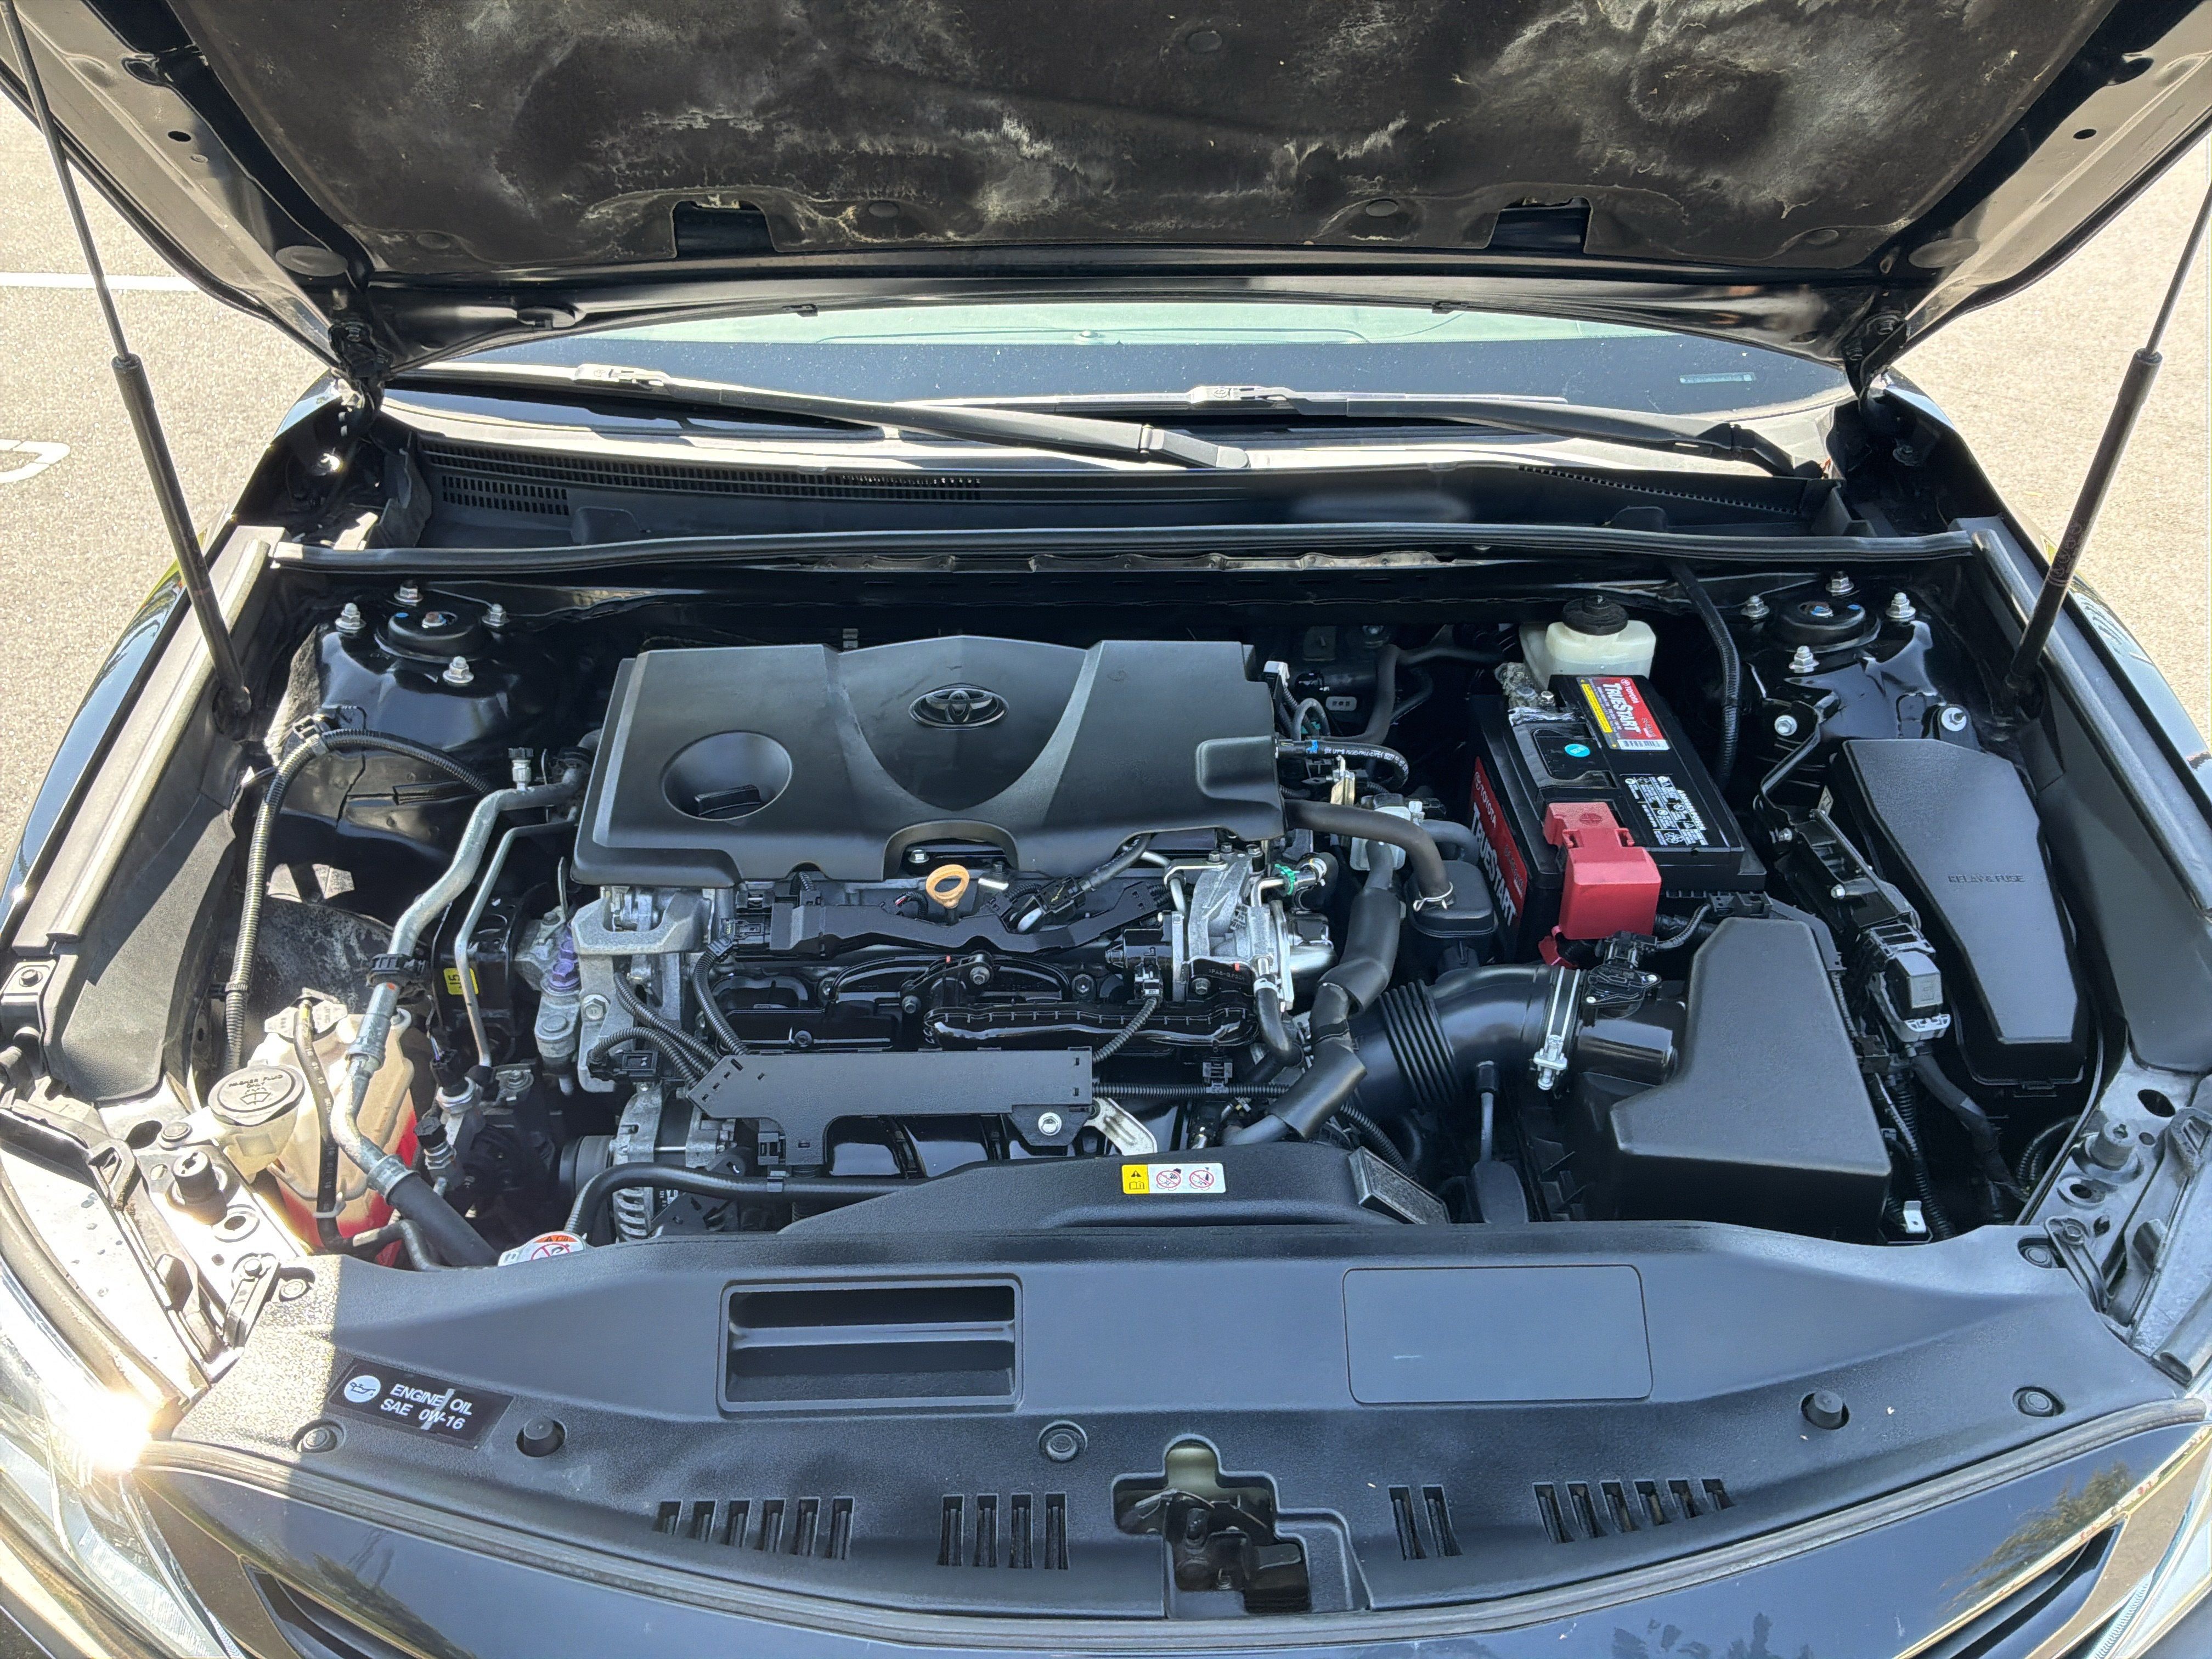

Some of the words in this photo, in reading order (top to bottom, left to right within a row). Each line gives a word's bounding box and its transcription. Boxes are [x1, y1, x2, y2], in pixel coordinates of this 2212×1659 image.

[1624, 685, 1639, 704] TOYOTA
[1480, 785, 1496, 828] TOYOTA
[381, 1398, 414, 1416] SAE
[418, 1409, 466, 1430] 0W-16
[390, 1384, 445, 1406] ENGINE
[450, 1399, 473, 1415] OIL
